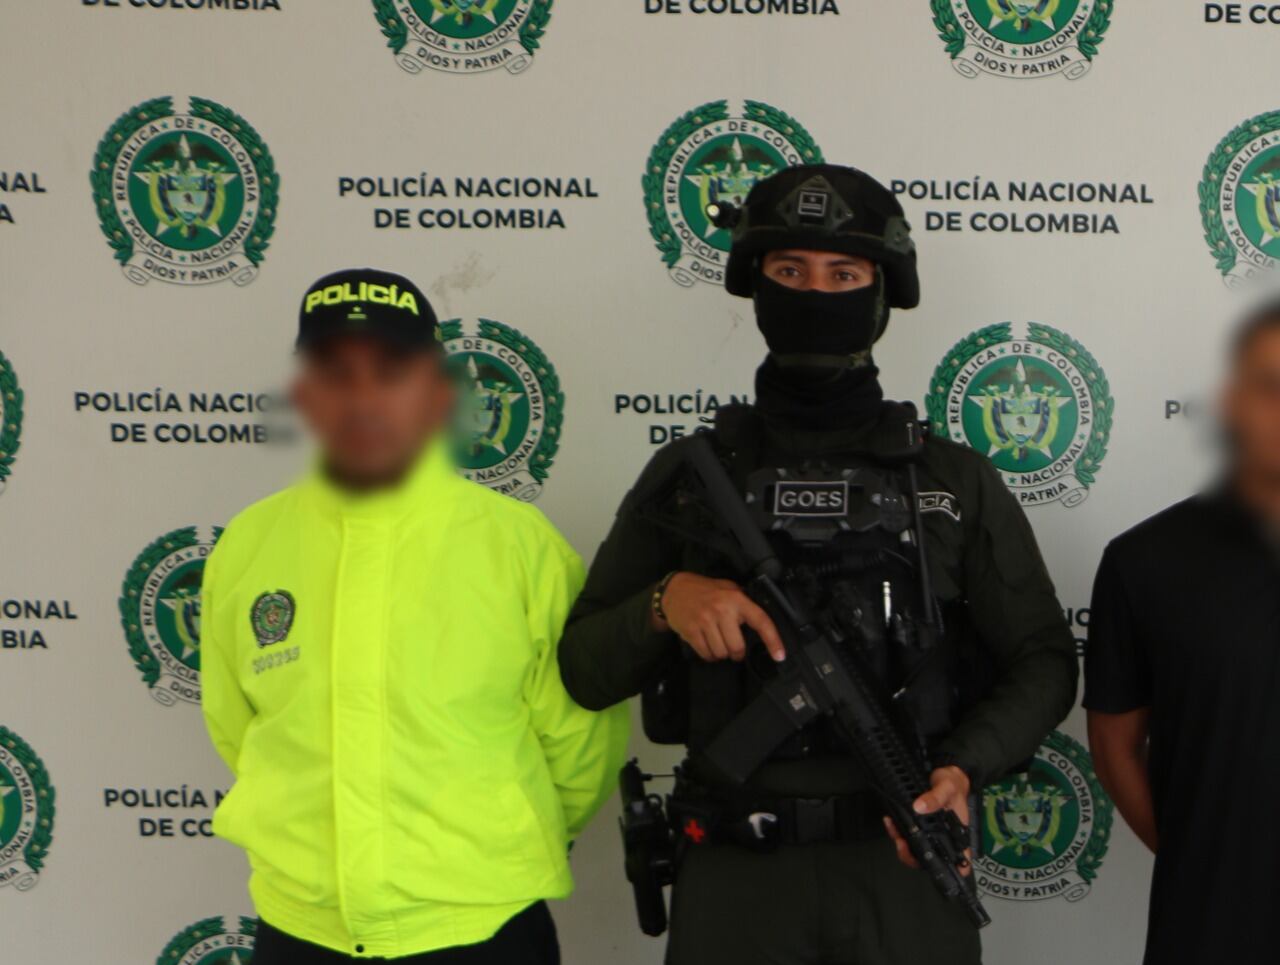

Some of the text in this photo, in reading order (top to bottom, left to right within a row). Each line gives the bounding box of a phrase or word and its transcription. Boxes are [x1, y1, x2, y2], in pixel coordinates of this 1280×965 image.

[645, 0, 839, 15] DE COLOMBIA
[1205, 4, 1241, 23] DE
[1023, 14, 1087, 56] NACIONAL
[974, 52, 1006, 72] DIOS
[1023, 54, 1070, 74] PATRIA
[175, 118, 194, 128] DE
[210, 127, 257, 202] COLOMBIA
[339, 173, 598, 197] POLICÍA NACIONAL
[890, 175, 1153, 204] POLICÍA NACIONAL
[374, 209, 565, 229] DE COLOMBIA
[925, 212, 1119, 234] DE COLOMBIA
[192, 220, 250, 262] NACIONAL
[144, 260, 176, 279] DIOS
[192, 261, 238, 280] PATRIA
[1012, 343, 1032, 353] DE
[1047, 352, 1090, 425] COLOMBIA
[74, 388, 271, 413] POLICÍA NACI
[615, 389, 720, 414] POLICÍA
[111, 423, 269, 443] DE COLOMB
[650, 425, 685, 444] DE
[1021, 442, 1084, 484] NACIONAL
[781, 491, 842, 507] GOES
[1020, 482, 1068, 502] PATRIA
[0, 600, 77, 619] ONAL
[105, 784, 208, 808] POLICÍA
[140, 818, 174, 836] DE
